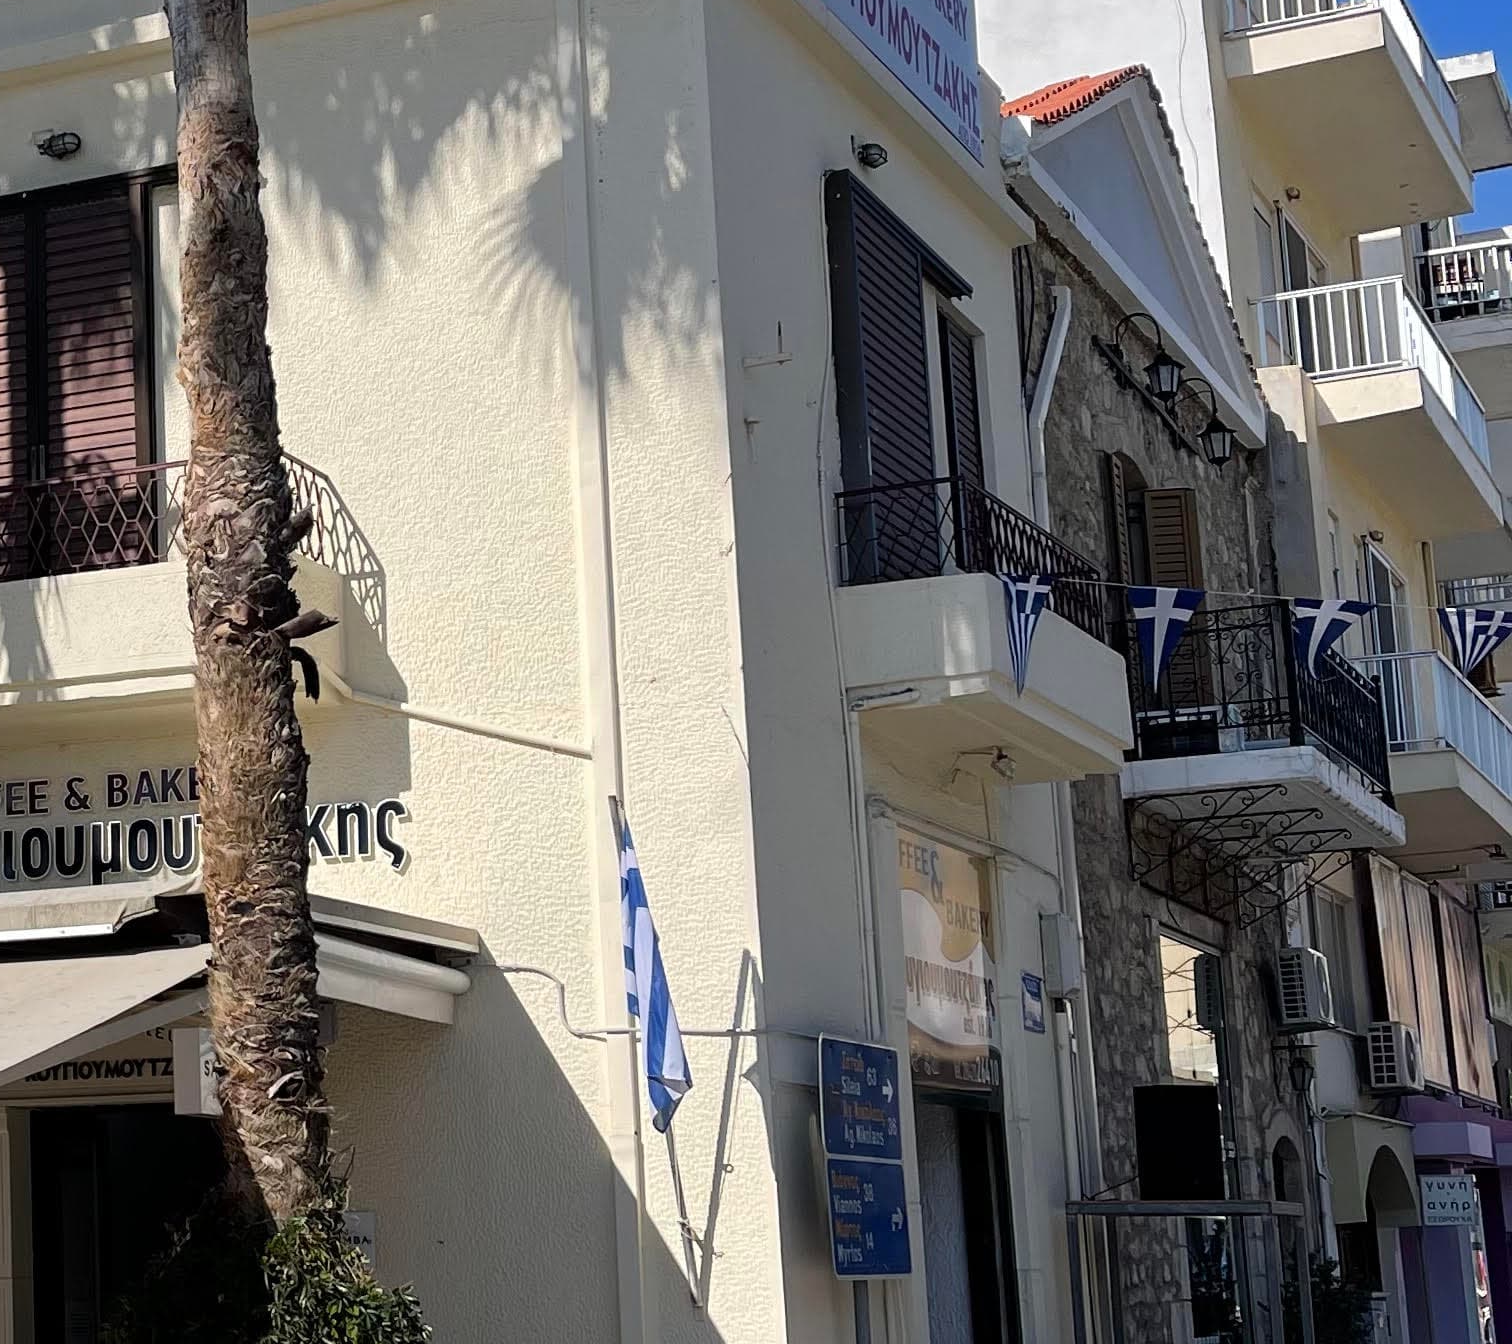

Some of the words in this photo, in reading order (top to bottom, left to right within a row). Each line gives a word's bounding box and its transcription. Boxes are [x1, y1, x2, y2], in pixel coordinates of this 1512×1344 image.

[63, 775, 92, 812] &
[106, 766, 201, 809] BAKE
[898, 838, 929, 876] FFEE
[866, 1066, 878, 1087] 63
[1425, 1177, 1468, 1193] γυνή
[1426, 1197, 1471, 1213] ανήρ
